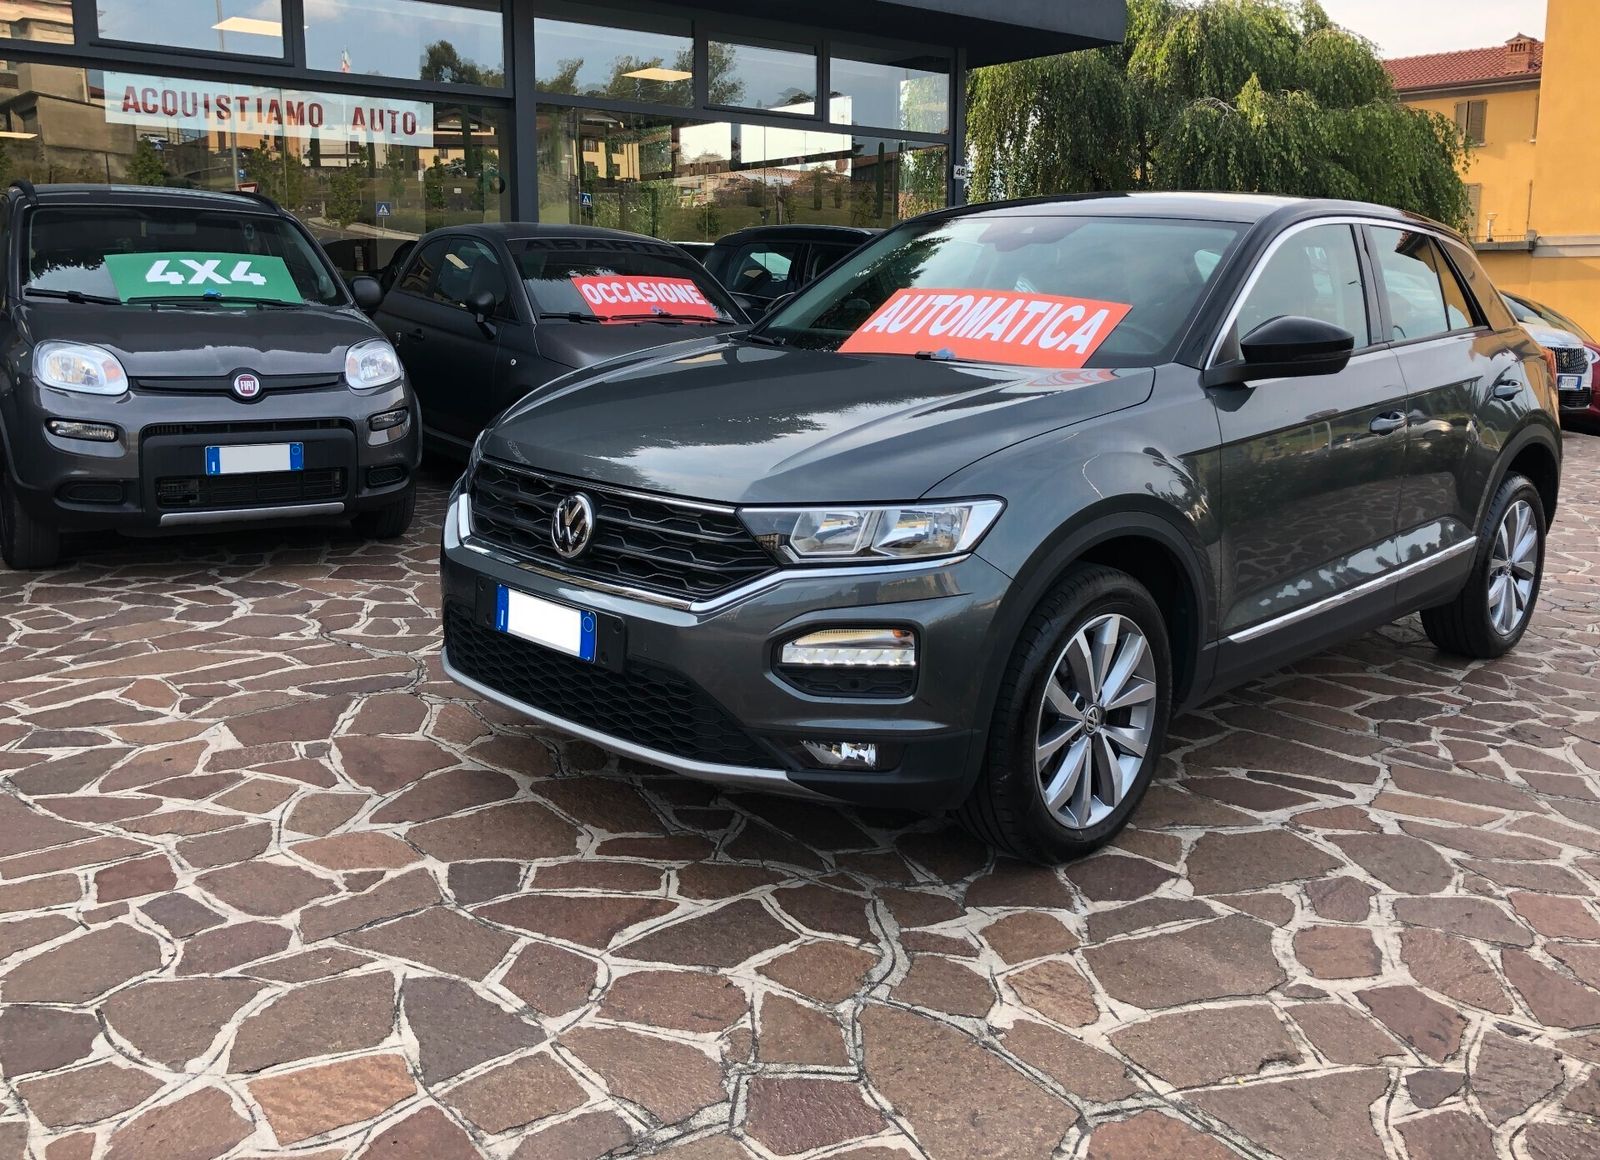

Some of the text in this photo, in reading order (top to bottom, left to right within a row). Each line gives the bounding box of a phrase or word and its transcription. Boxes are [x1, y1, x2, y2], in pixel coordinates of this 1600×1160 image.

[122, 86, 417, 136] ACQUISTIAMO AUTO
[956, 168, 966, 176] 46
[145, 260, 267, 286] 4X4
[581, 283, 707, 305] OCCASIONE
[863, 294, 1110, 354] AUTOMATICA
[240, 381, 255, 391] FIAT
